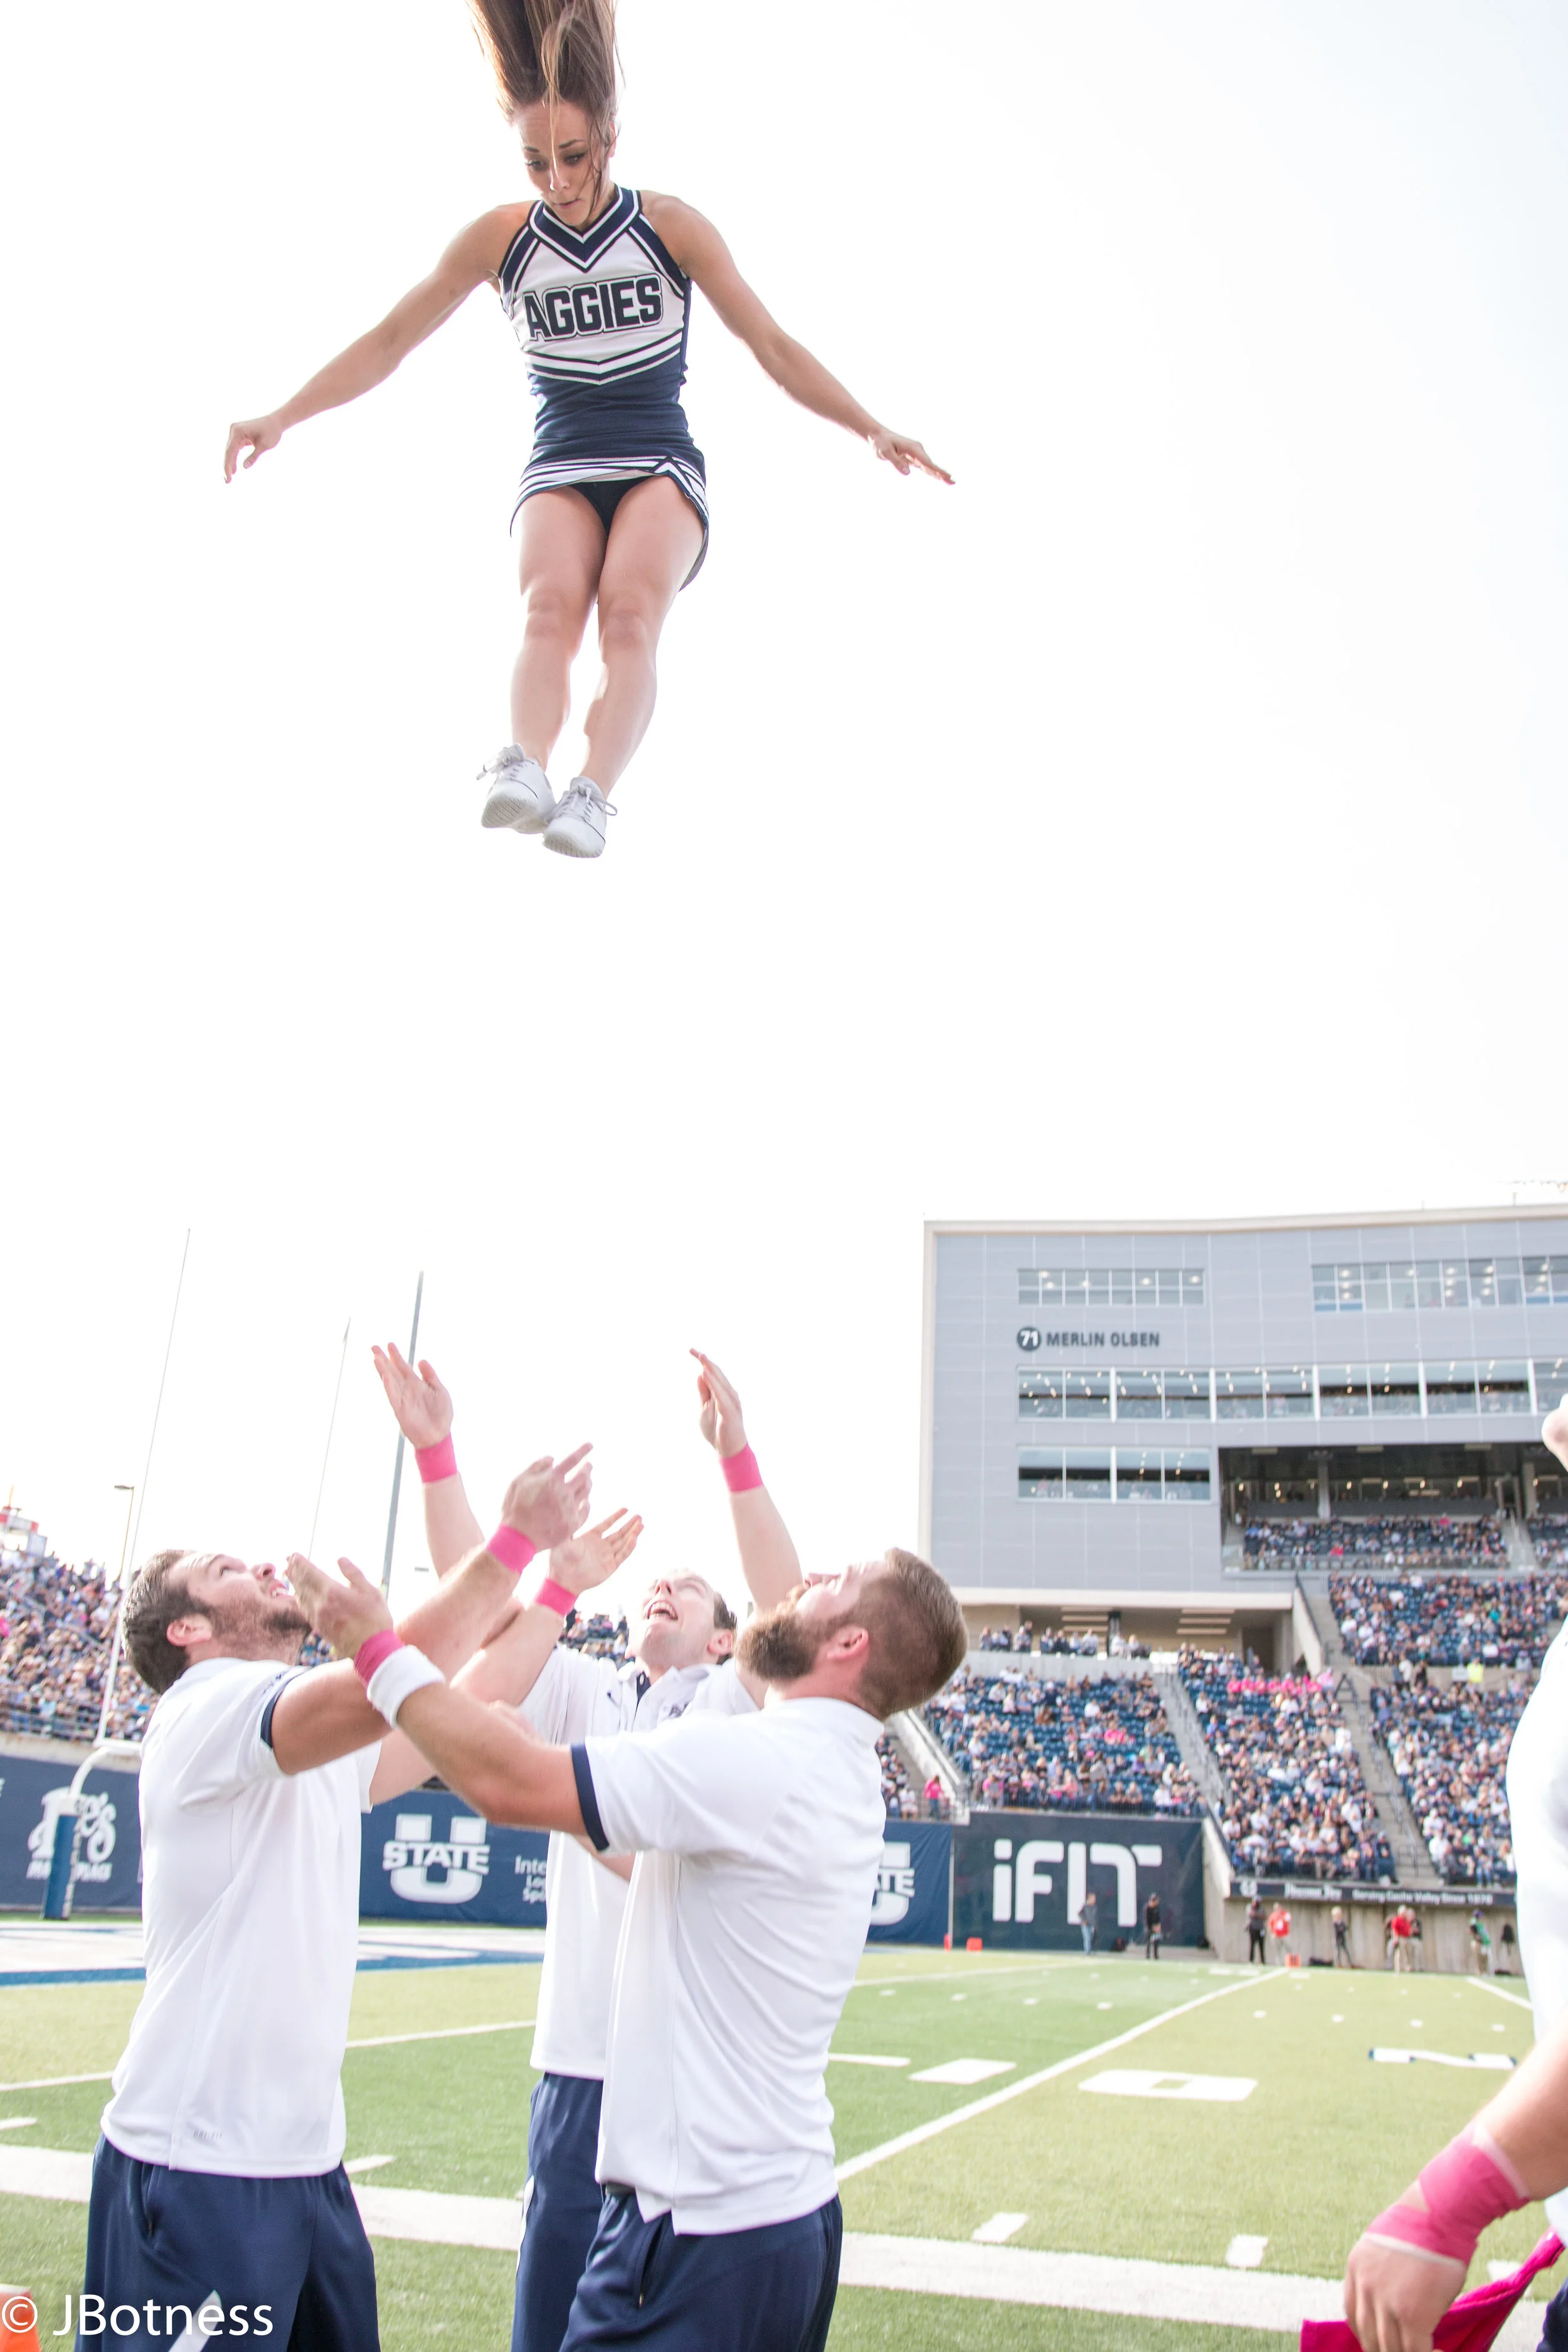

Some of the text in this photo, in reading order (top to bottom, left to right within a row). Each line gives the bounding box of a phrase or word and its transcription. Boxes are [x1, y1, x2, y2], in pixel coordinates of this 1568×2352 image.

[523, 273, 663, 341] AGGIES
[1019, 1330, 1160, 1347] 71 MERLIN OLSEN
[382, 1840, 490, 1875] STATE
